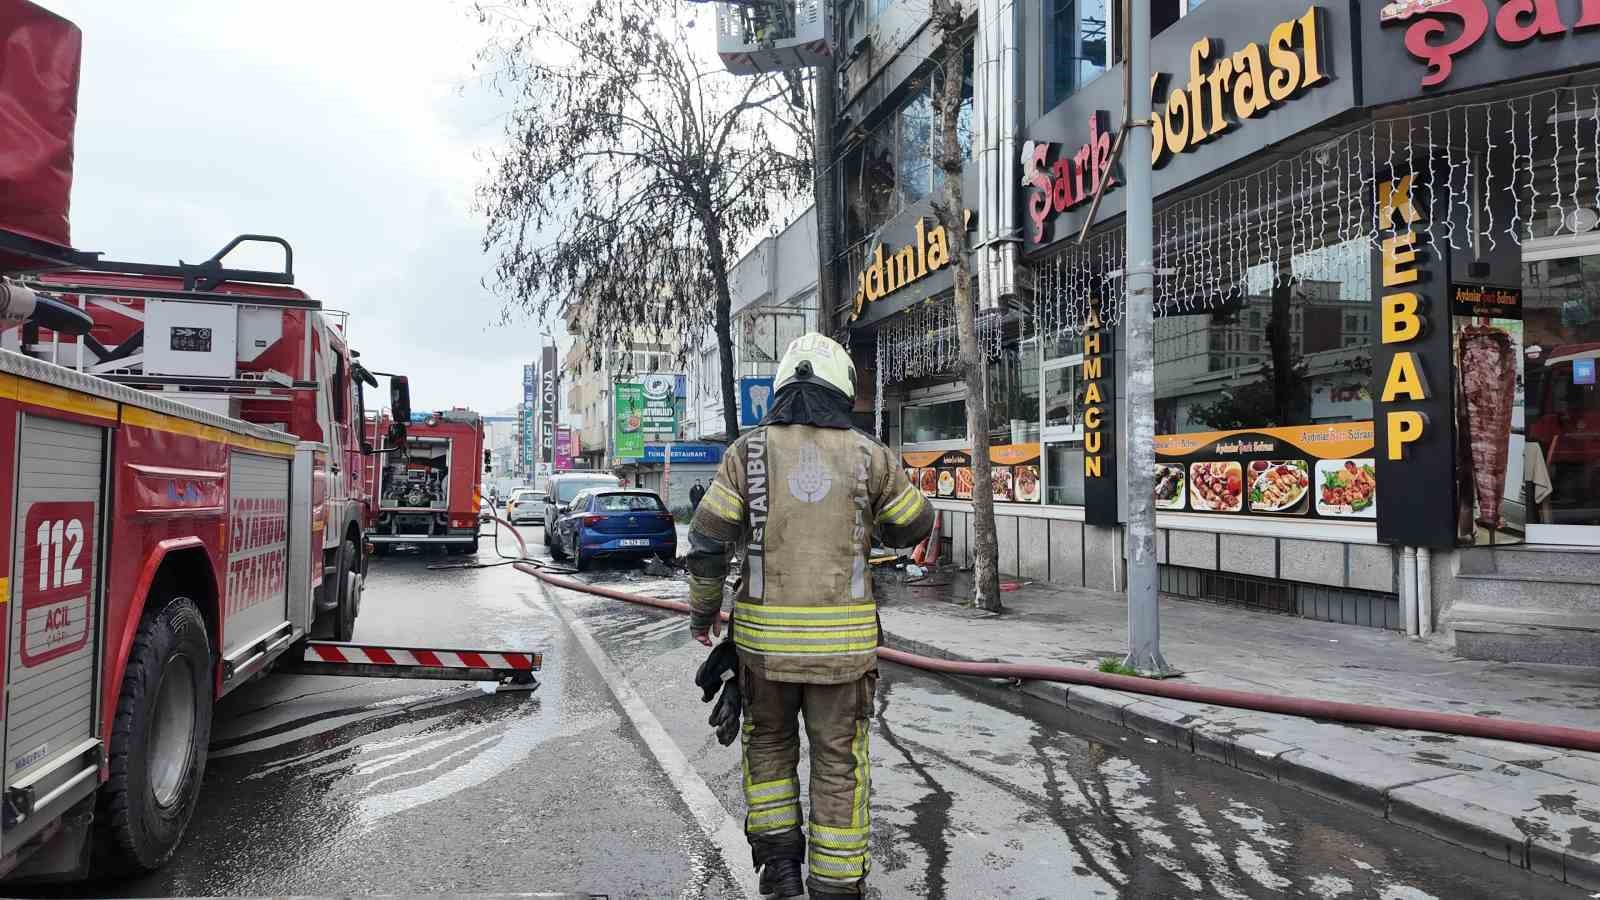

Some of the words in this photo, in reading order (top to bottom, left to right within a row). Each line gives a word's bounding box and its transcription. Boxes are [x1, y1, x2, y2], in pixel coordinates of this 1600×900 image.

[1022, 111, 1116, 244] Şark
[1379, 174, 1425, 460] KEBAP
[543, 369, 556, 449] BELLONA
[1084, 298, 1103, 477] AHMACUN
[37, 518, 85, 592] 112
